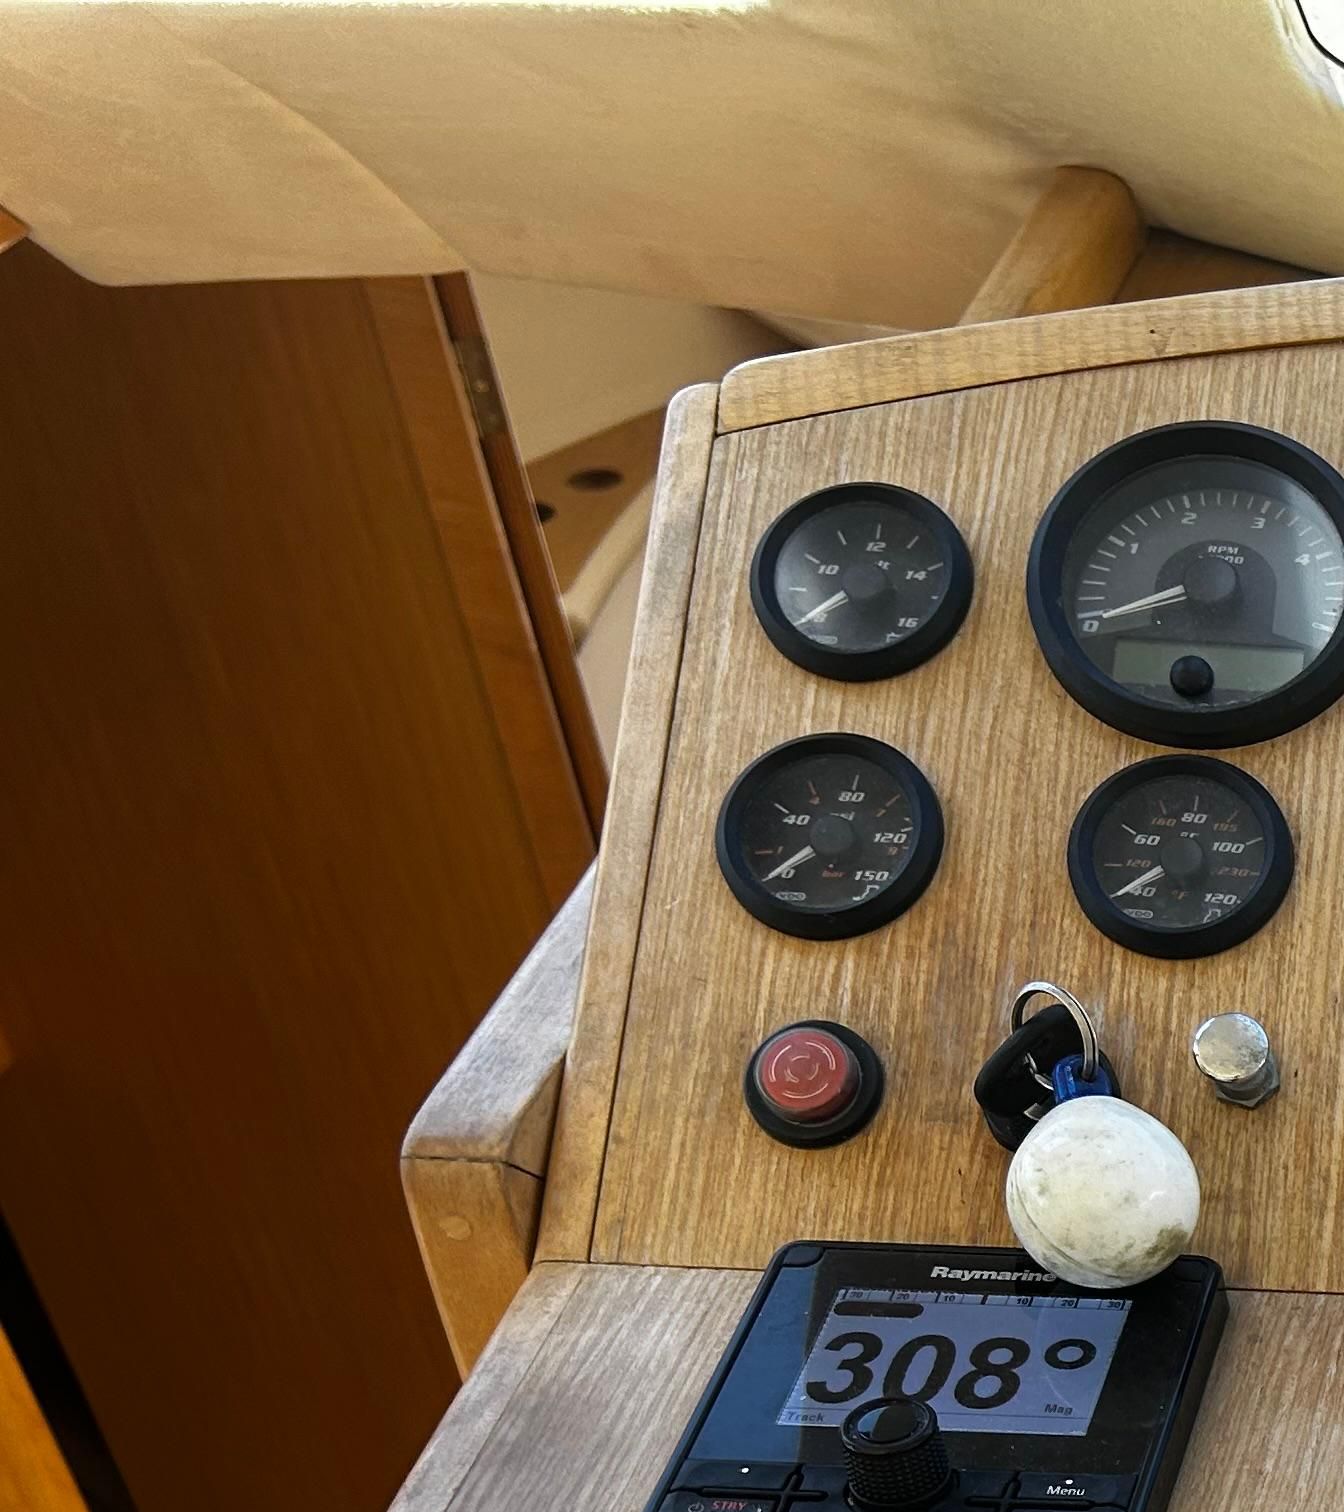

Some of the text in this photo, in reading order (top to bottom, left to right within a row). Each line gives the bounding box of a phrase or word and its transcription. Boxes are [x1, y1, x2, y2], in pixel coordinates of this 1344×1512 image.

[1181, 511, 1198, 525] 2
[1250, 516, 1266, 529] 3
[866, 541, 887, 553] 12
[1129, 542, 1141, 555] 1
[1207, 545, 1240, 555] RPM
[1294, 553, 1311, 566] 4
[817, 564, 840, 576] 10
[905, 570, 927, 581] 14
[897, 617, 919, 628] 16
[1082, 620, 1100, 632] 0
[838, 791, 865, 802] 80
[782, 814, 811, 826] 40
[1181, 811, 1208, 824] 80
[873, 832, 907, 844] 120
[1133, 833, 1161, 846] 60
[1212, 841, 1245, 854] 100
[854, 870, 889, 882] 150
[1204, 892, 1237, 905] 120
[930, 1265, 1058, 1283] Raymarine
[806, 1331, 1097, 1410] 308°
[1043, 1402, 1074, 1418] Mag
[784, 1411, 825, 1425] Track
[1046, 1484, 1086, 1498] Menu
